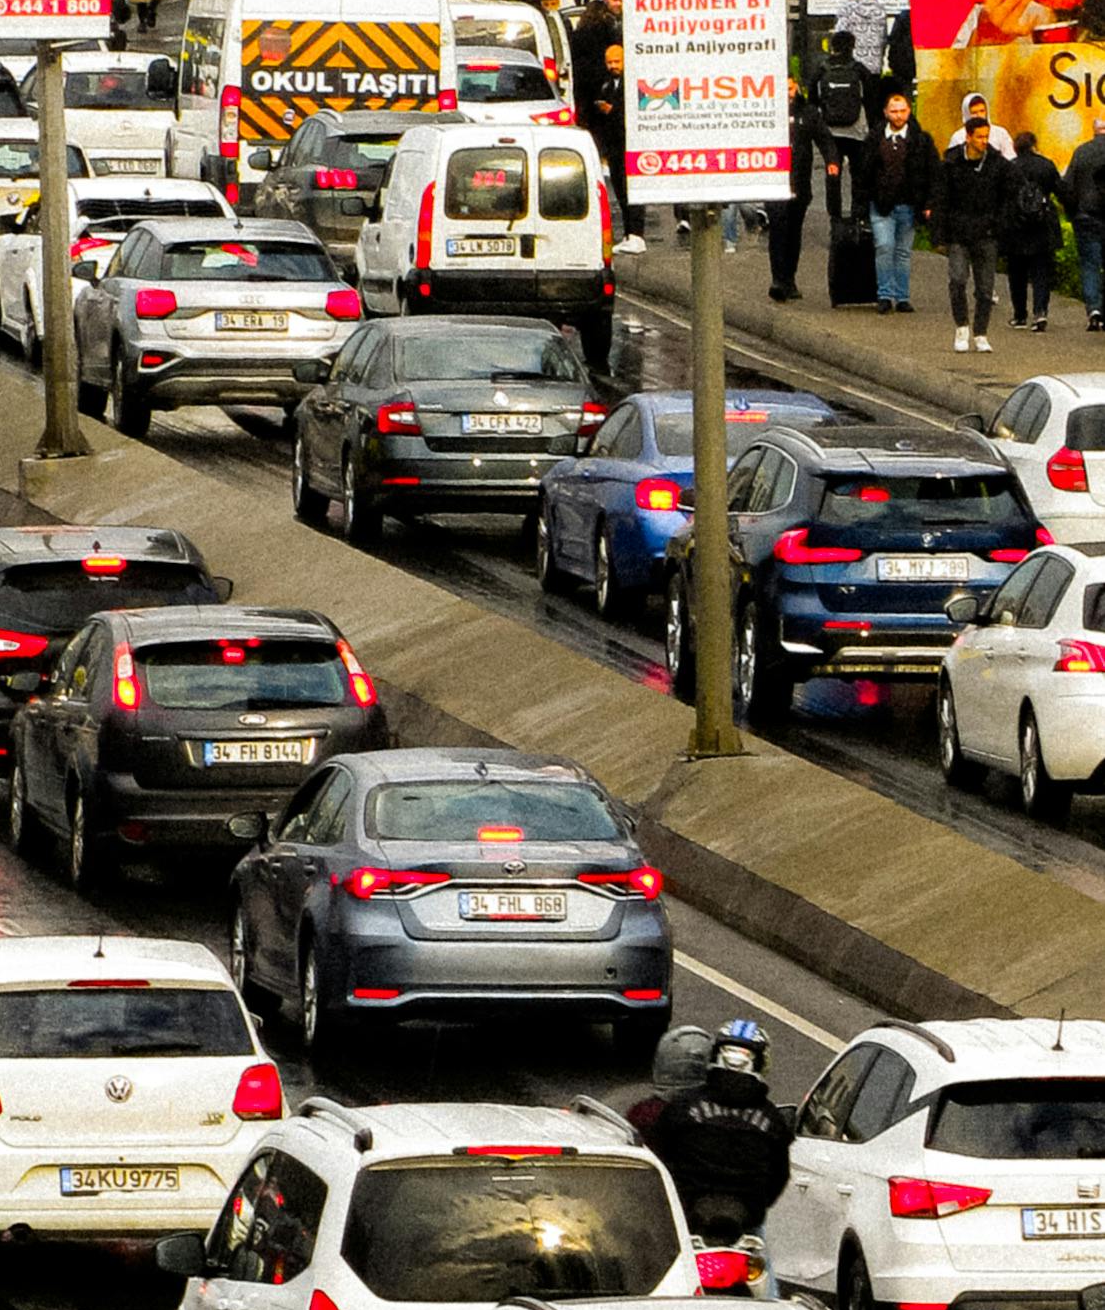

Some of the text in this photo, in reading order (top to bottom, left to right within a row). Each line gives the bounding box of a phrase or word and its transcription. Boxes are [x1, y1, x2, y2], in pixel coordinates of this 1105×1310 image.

[10, 0, 101, 14] 444 1 800
[643, 13, 766, 35] Anjiyografi
[635, 38, 776, 55] Sanal Anjiyografi
[251, 70, 436, 98] OKUL TAŞITI
[682, 75, 775, 100] HSM
[666, 151, 778, 171] 444 1 800
[454, 240, 466, 252] 34
[224, 314, 285, 327] 34 ERA 19
[470, 415, 484, 428] 34
[516, 415, 538, 428] 422
[885, 561, 901, 576] 34
[213, 743, 300, 759] 34 FH 8144
[470, 895, 562, 913] 34 FHL 868
[1035, 1212, 1102, 1232] 34 HIS
